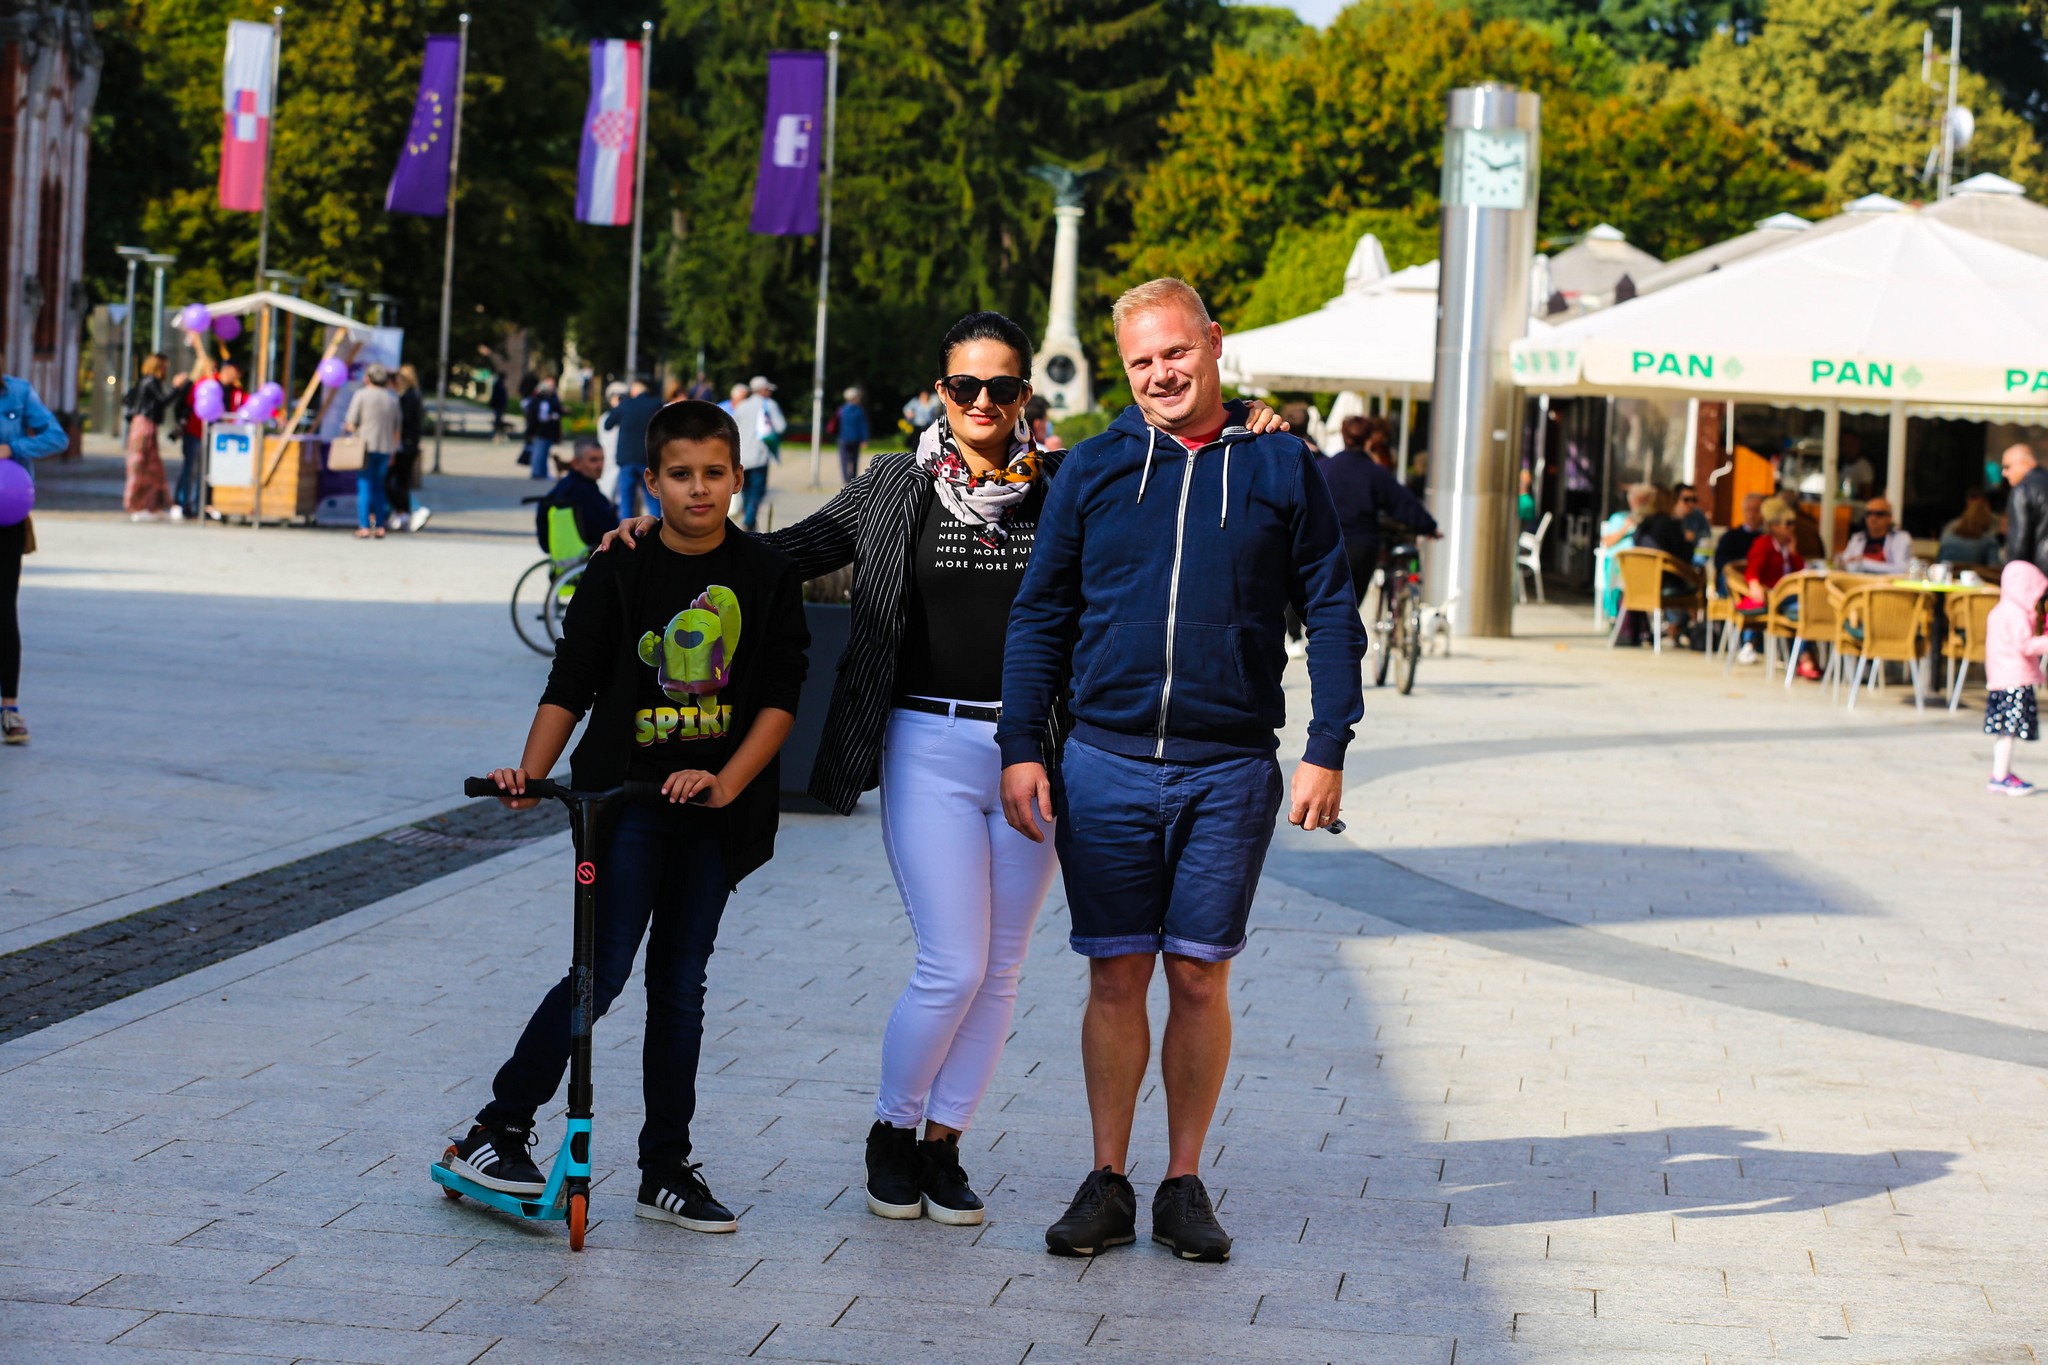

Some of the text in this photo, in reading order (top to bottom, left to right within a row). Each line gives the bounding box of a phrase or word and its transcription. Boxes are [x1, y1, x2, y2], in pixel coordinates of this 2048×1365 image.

[1632, 351, 1714, 379] PAN
[1811, 360, 1893, 388] PAN
[938, 533, 967, 541] NEED
[1010, 534, 1035, 542] TIME
[936, 546, 967, 554] NEED
[973, 548, 1006, 556] MORE
[935, 560, 969, 568] MORE
[974, 562, 1008, 571] MORE
